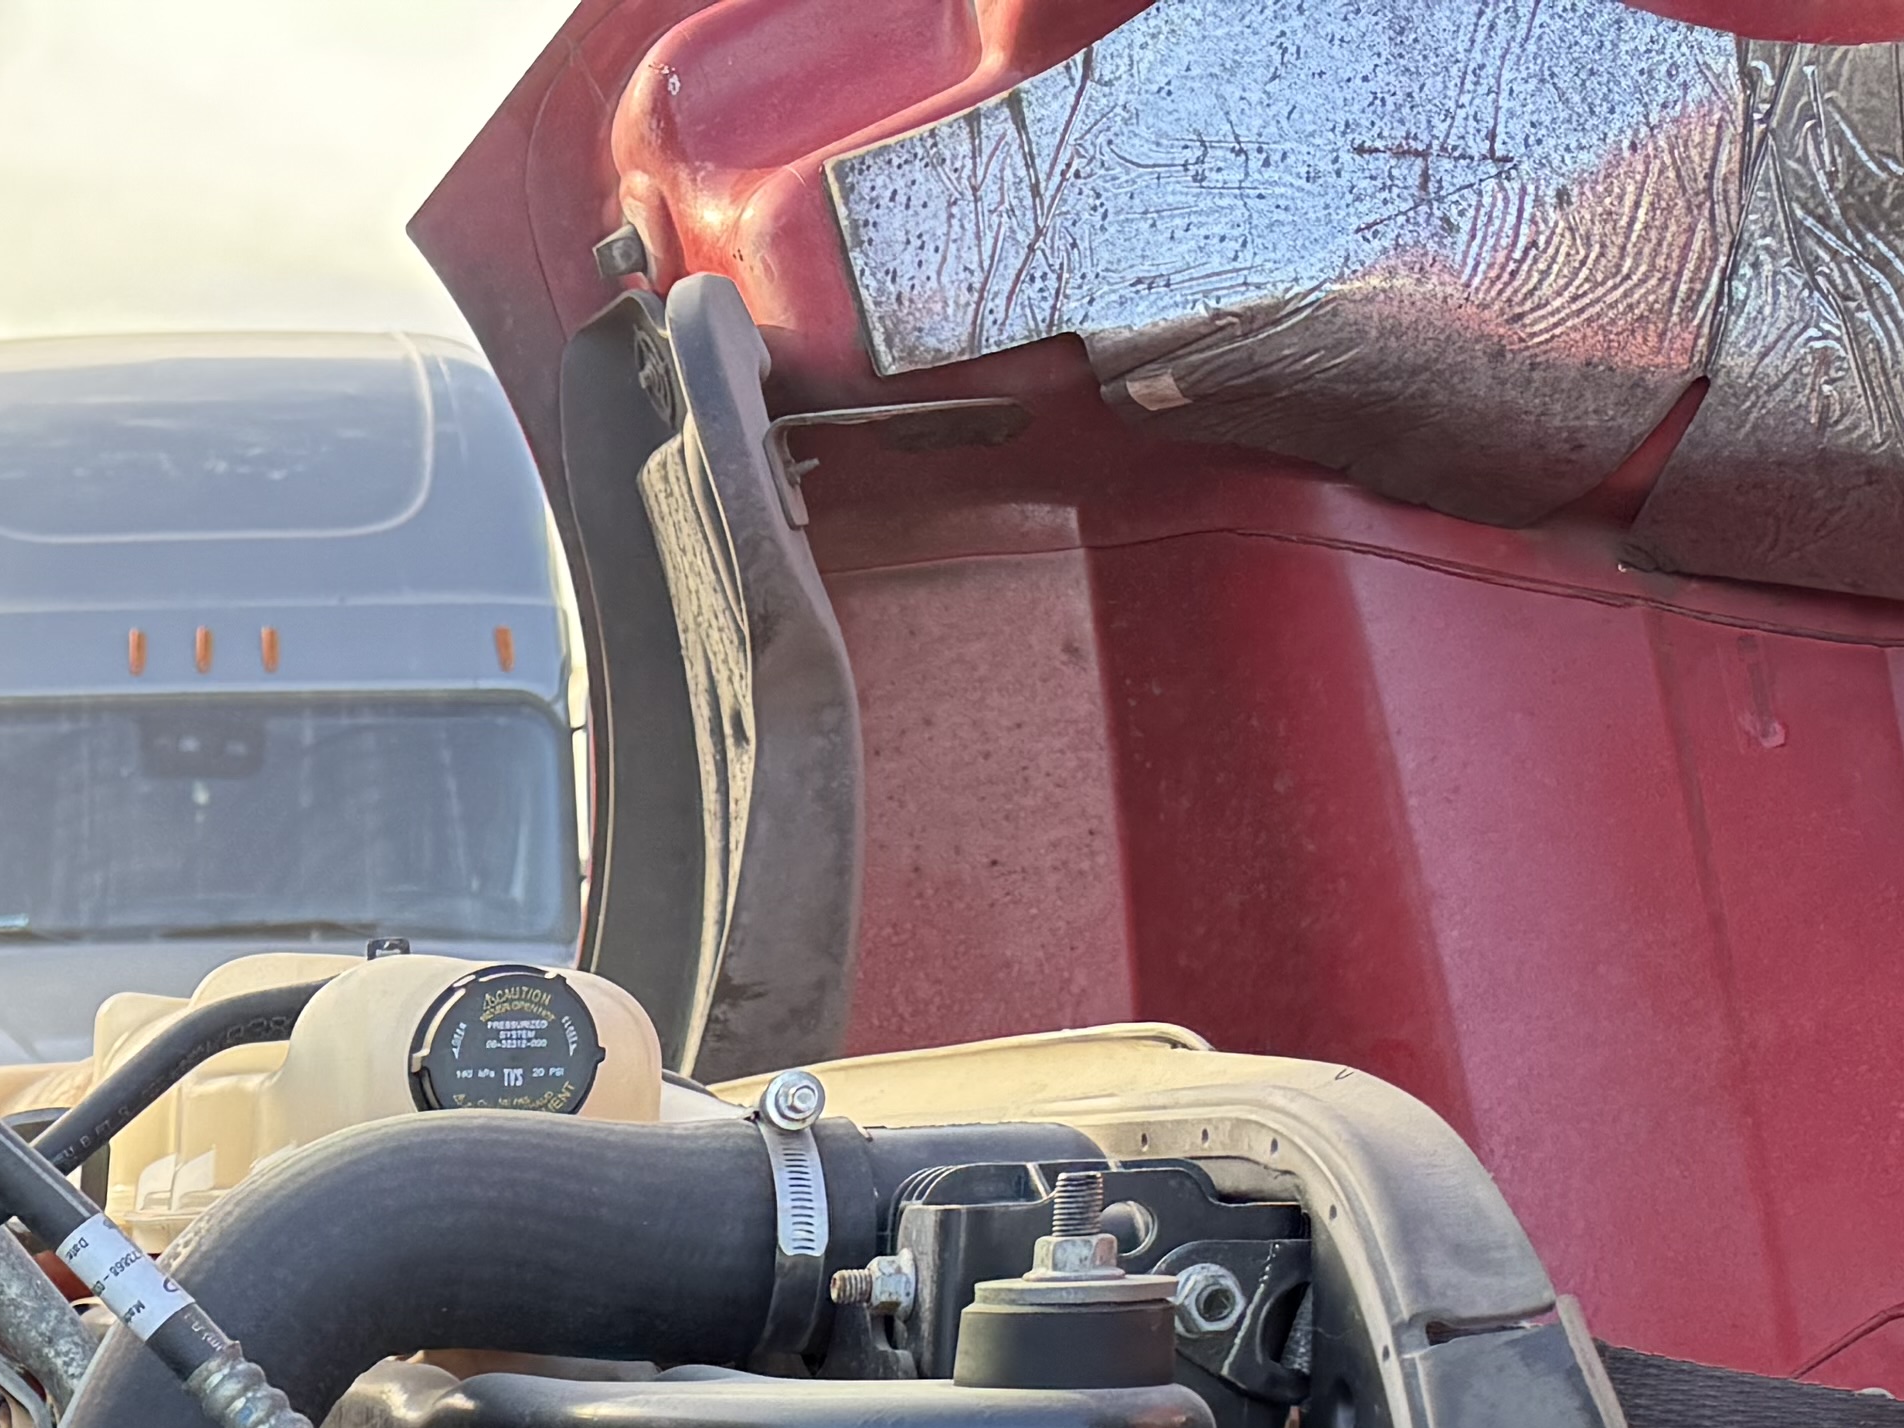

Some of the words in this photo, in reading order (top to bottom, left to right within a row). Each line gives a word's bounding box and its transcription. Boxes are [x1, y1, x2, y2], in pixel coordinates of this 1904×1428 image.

[496, 986, 552, 1006] CAUTION
[487, 1020, 549, 1029] PRESSURIZED
[499, 1030, 536, 1039] SYSTEM
[503, 1068, 524, 1087] TVS
